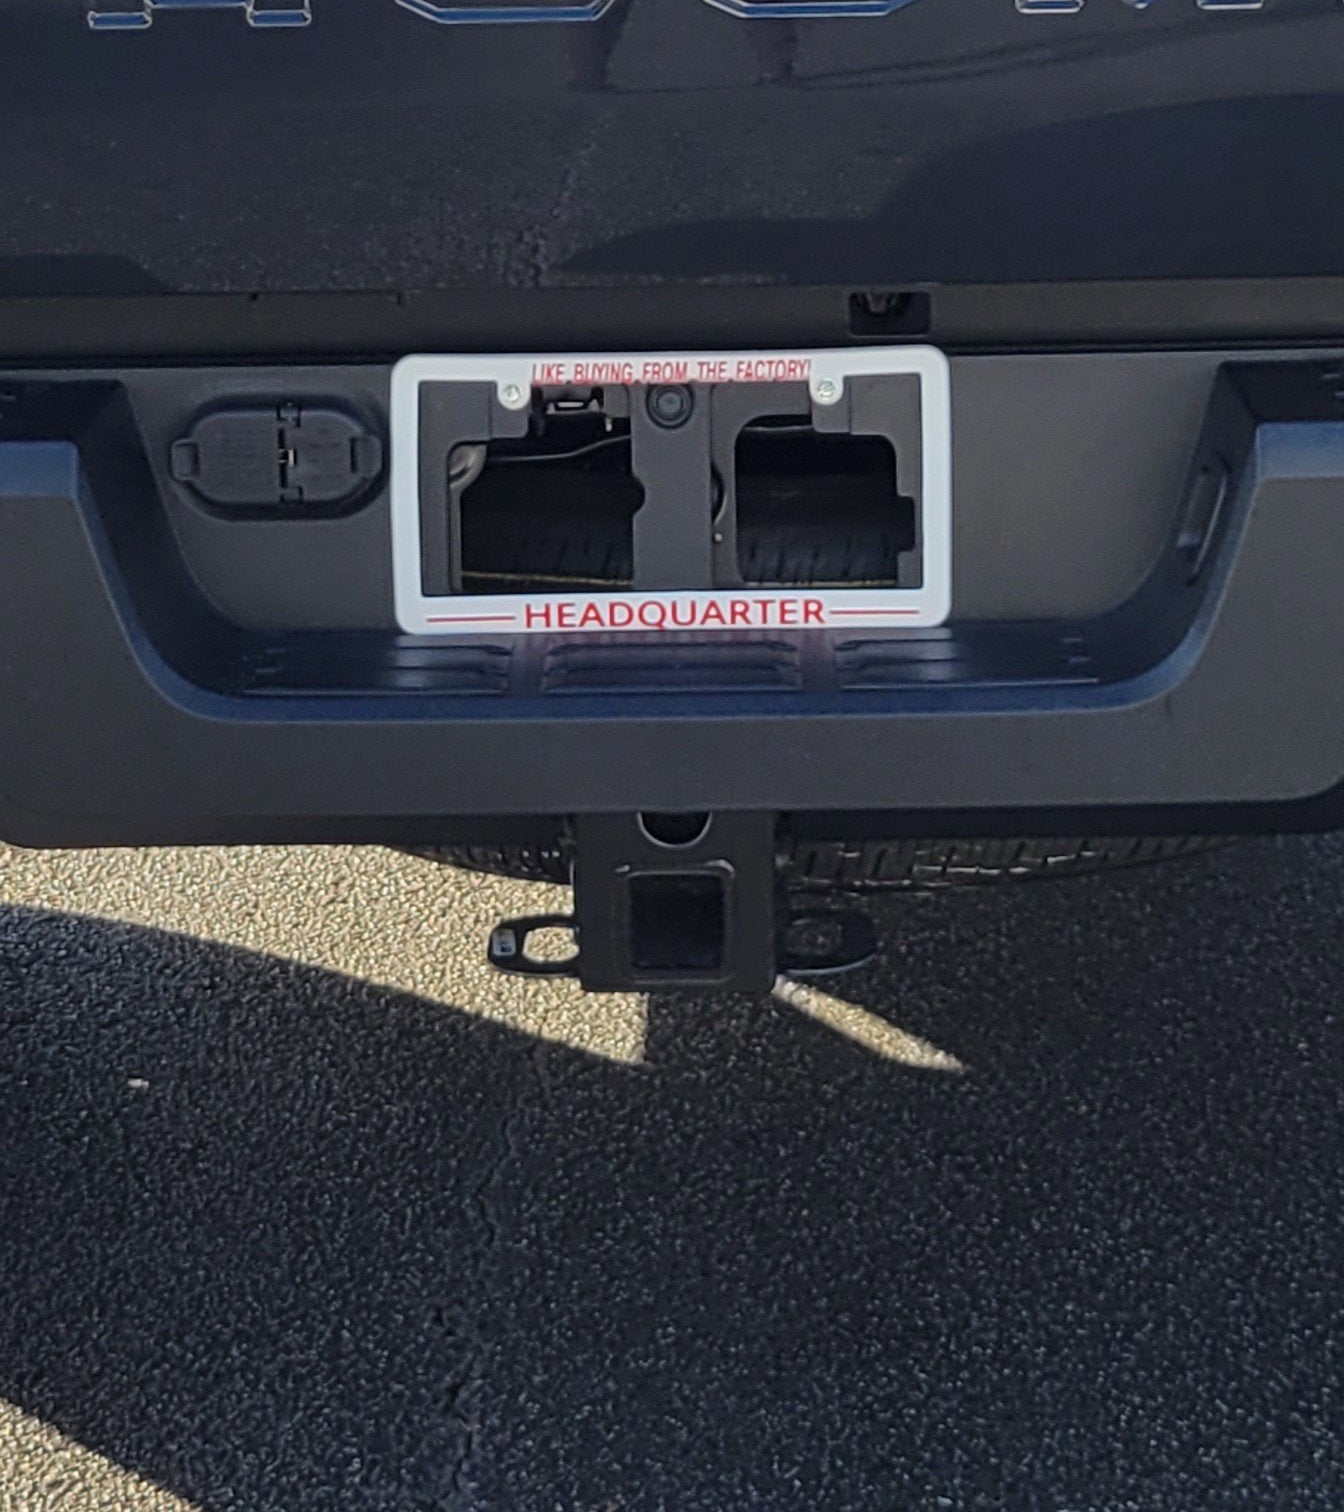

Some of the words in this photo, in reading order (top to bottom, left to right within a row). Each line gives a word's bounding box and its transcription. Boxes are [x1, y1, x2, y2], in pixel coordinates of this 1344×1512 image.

[530, 363, 565, 385] LIKE
[573, 362, 634, 384] BUYING
[642, 361, 689, 382] FROM
[697, 360, 728, 381] THE
[524, 598, 825, 630] HEADQUARTER
